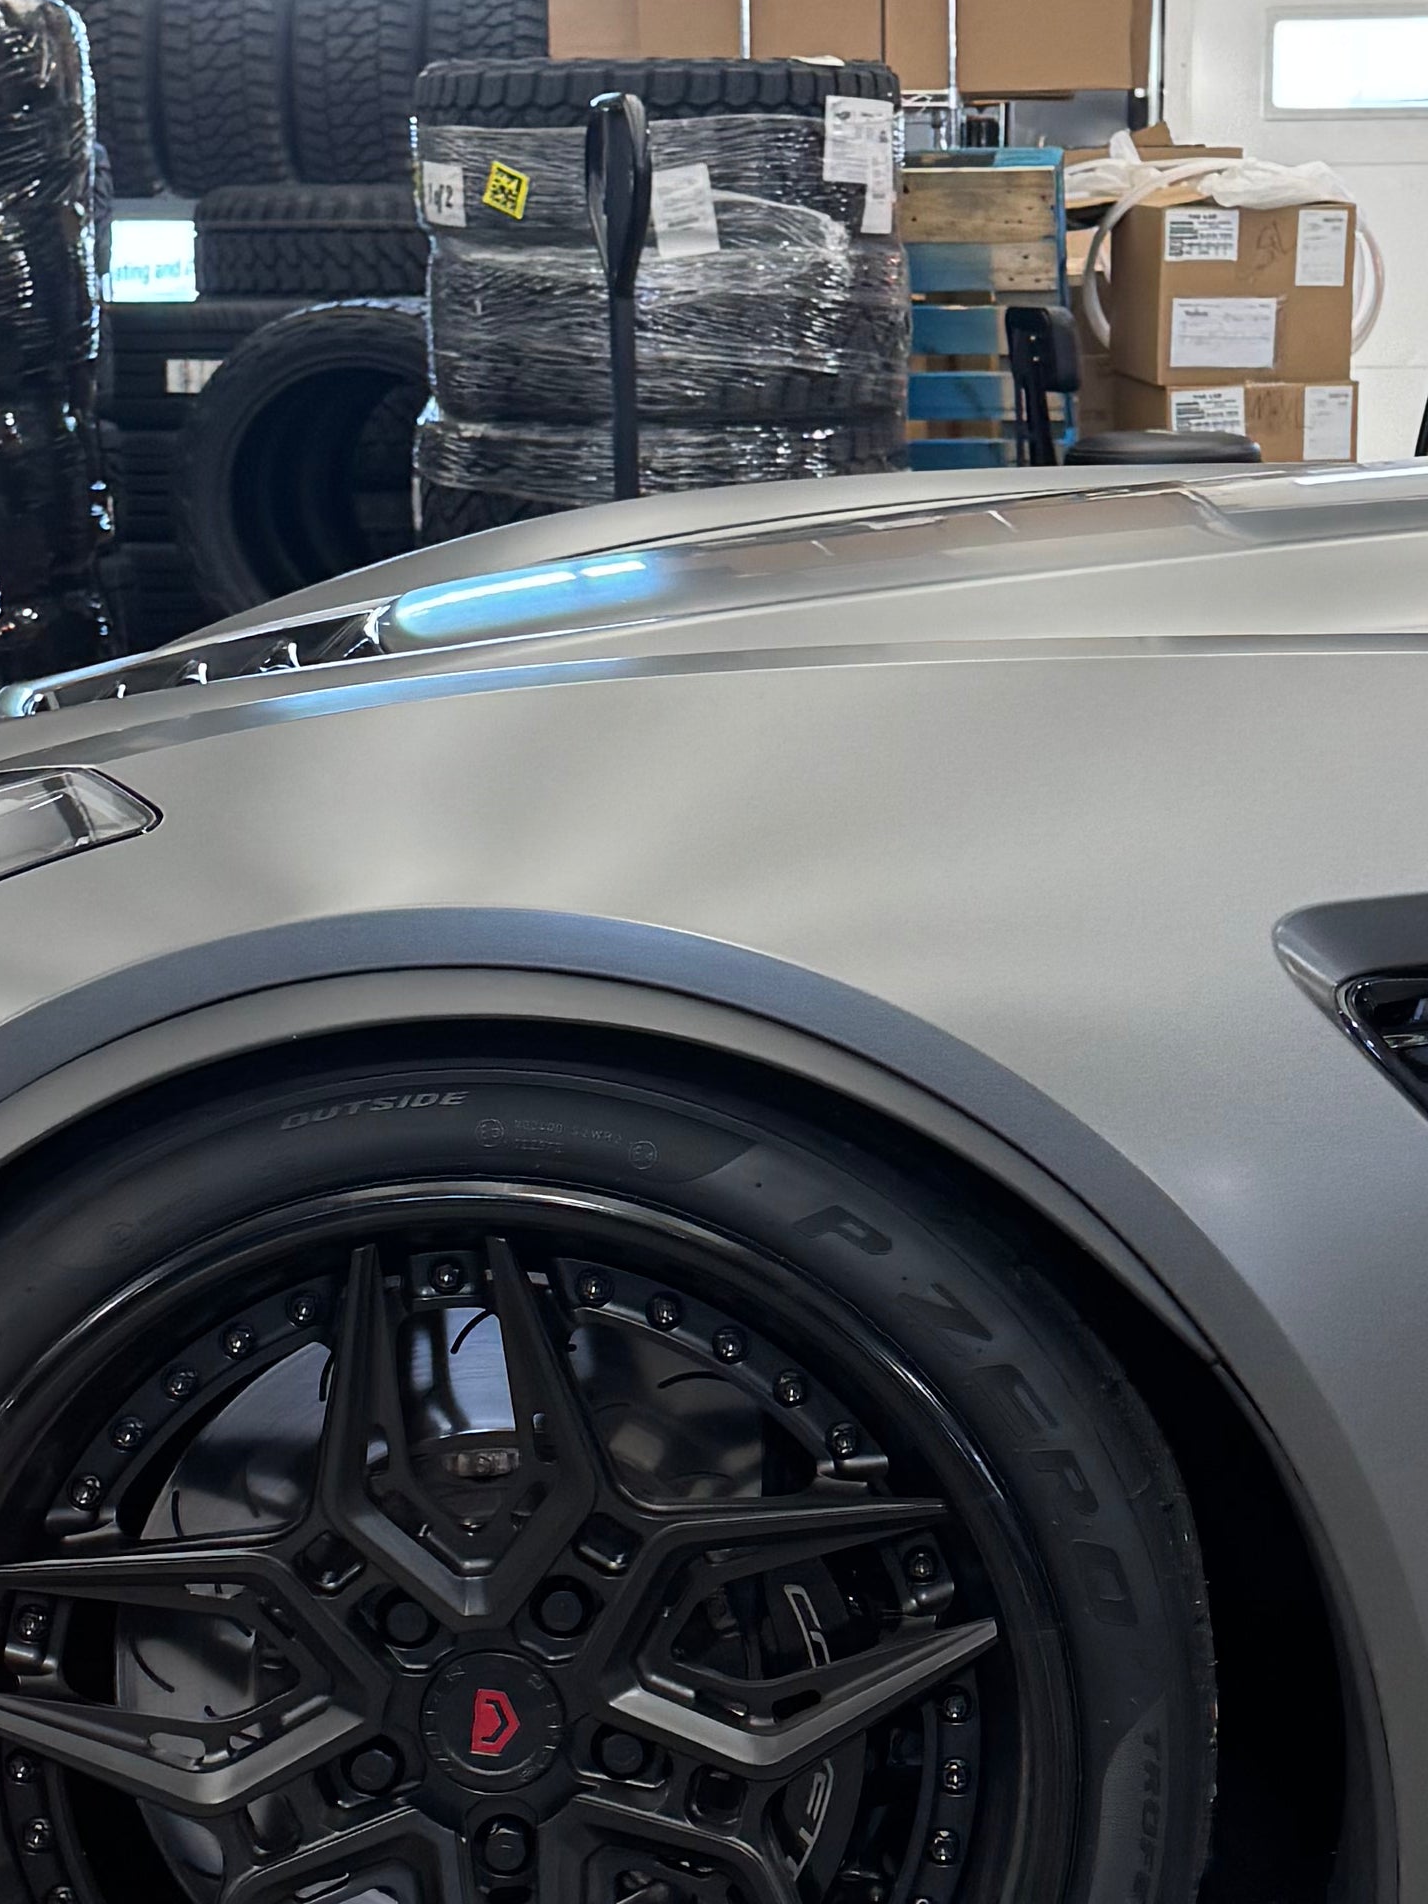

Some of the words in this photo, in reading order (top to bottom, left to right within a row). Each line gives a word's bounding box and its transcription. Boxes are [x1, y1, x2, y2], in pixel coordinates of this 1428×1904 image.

[280, 1090, 470, 1131] OUTSIDE
[793, 1204, 893, 1256] P
[895, 1282, 1139, 1629] ZERO
